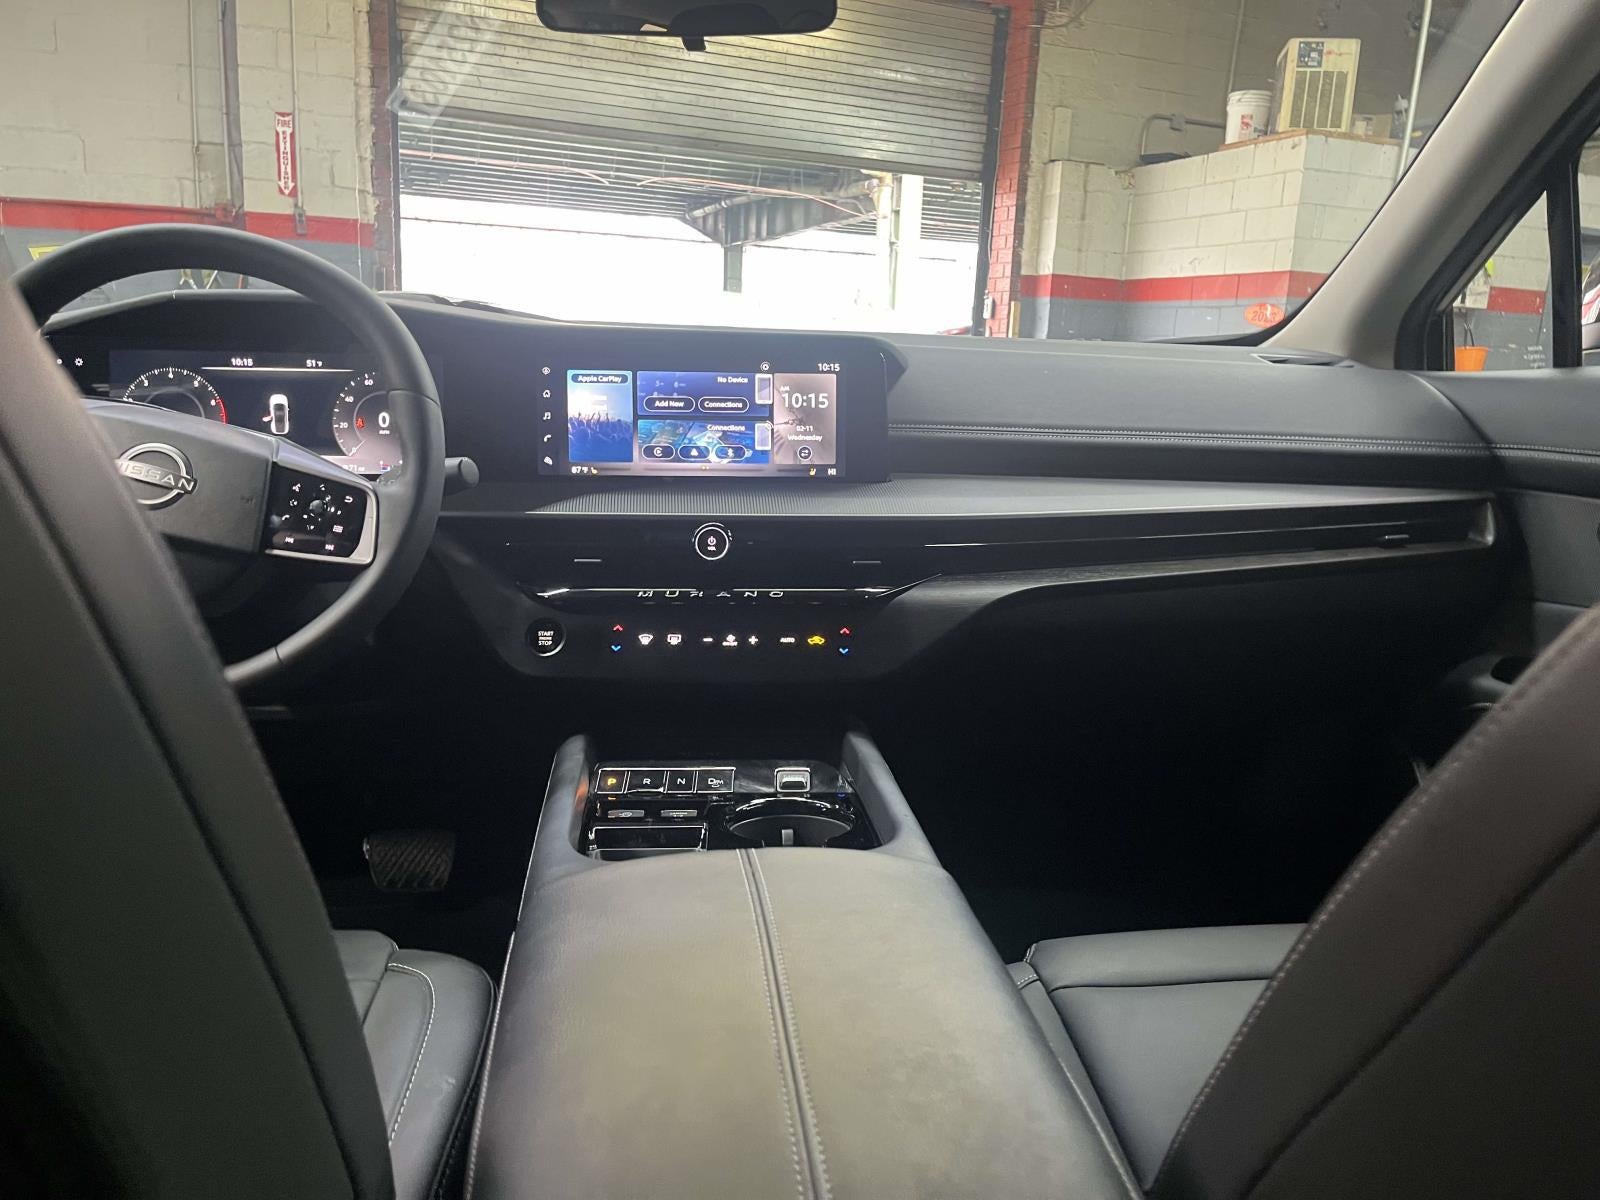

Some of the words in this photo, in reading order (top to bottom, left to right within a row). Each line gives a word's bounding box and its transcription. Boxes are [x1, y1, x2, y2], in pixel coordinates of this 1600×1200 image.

[277, 119, 291, 128] FIRE
[230, 357, 254, 367] 10:15
[817, 362, 840, 372] 10:15
[577, 375, 597, 383] Apple
[598, 375, 622, 383] CarPlay
[704, 400, 743, 408] Connections
[781, 392, 829, 409] 10:15
[377, 411, 390, 428] 0
[787, 434, 823, 442] Wednesday
[120, 462, 195, 491] ISSAN
[636, 589, 784, 598] MURANO
[607, 777, 617, 786] P
